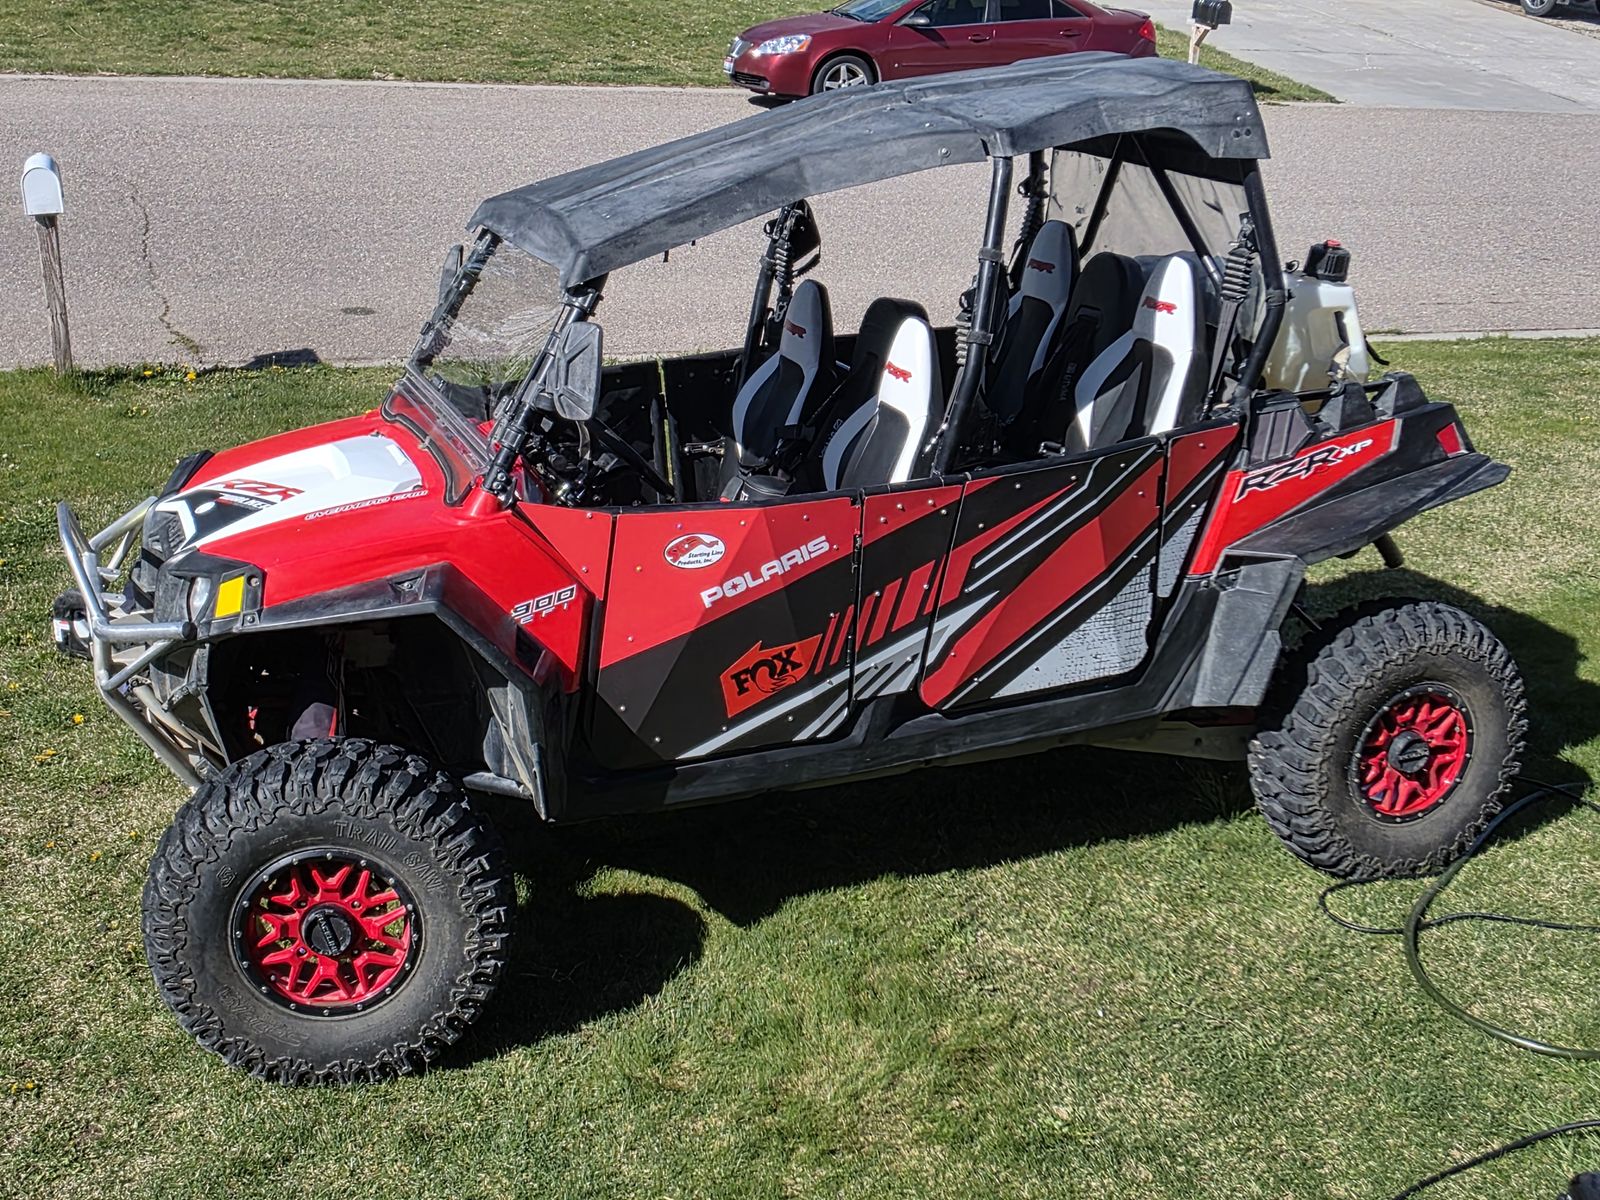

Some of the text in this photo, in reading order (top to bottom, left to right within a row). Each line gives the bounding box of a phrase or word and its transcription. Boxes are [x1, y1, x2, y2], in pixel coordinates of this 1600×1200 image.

[1232, 438, 1373, 503] RZR XP
[700, 535, 830, 608] POLARIS
[511, 584, 577, 620] 900
[520, 602, 568, 625] EFI
[730, 645, 804, 697] FOX
